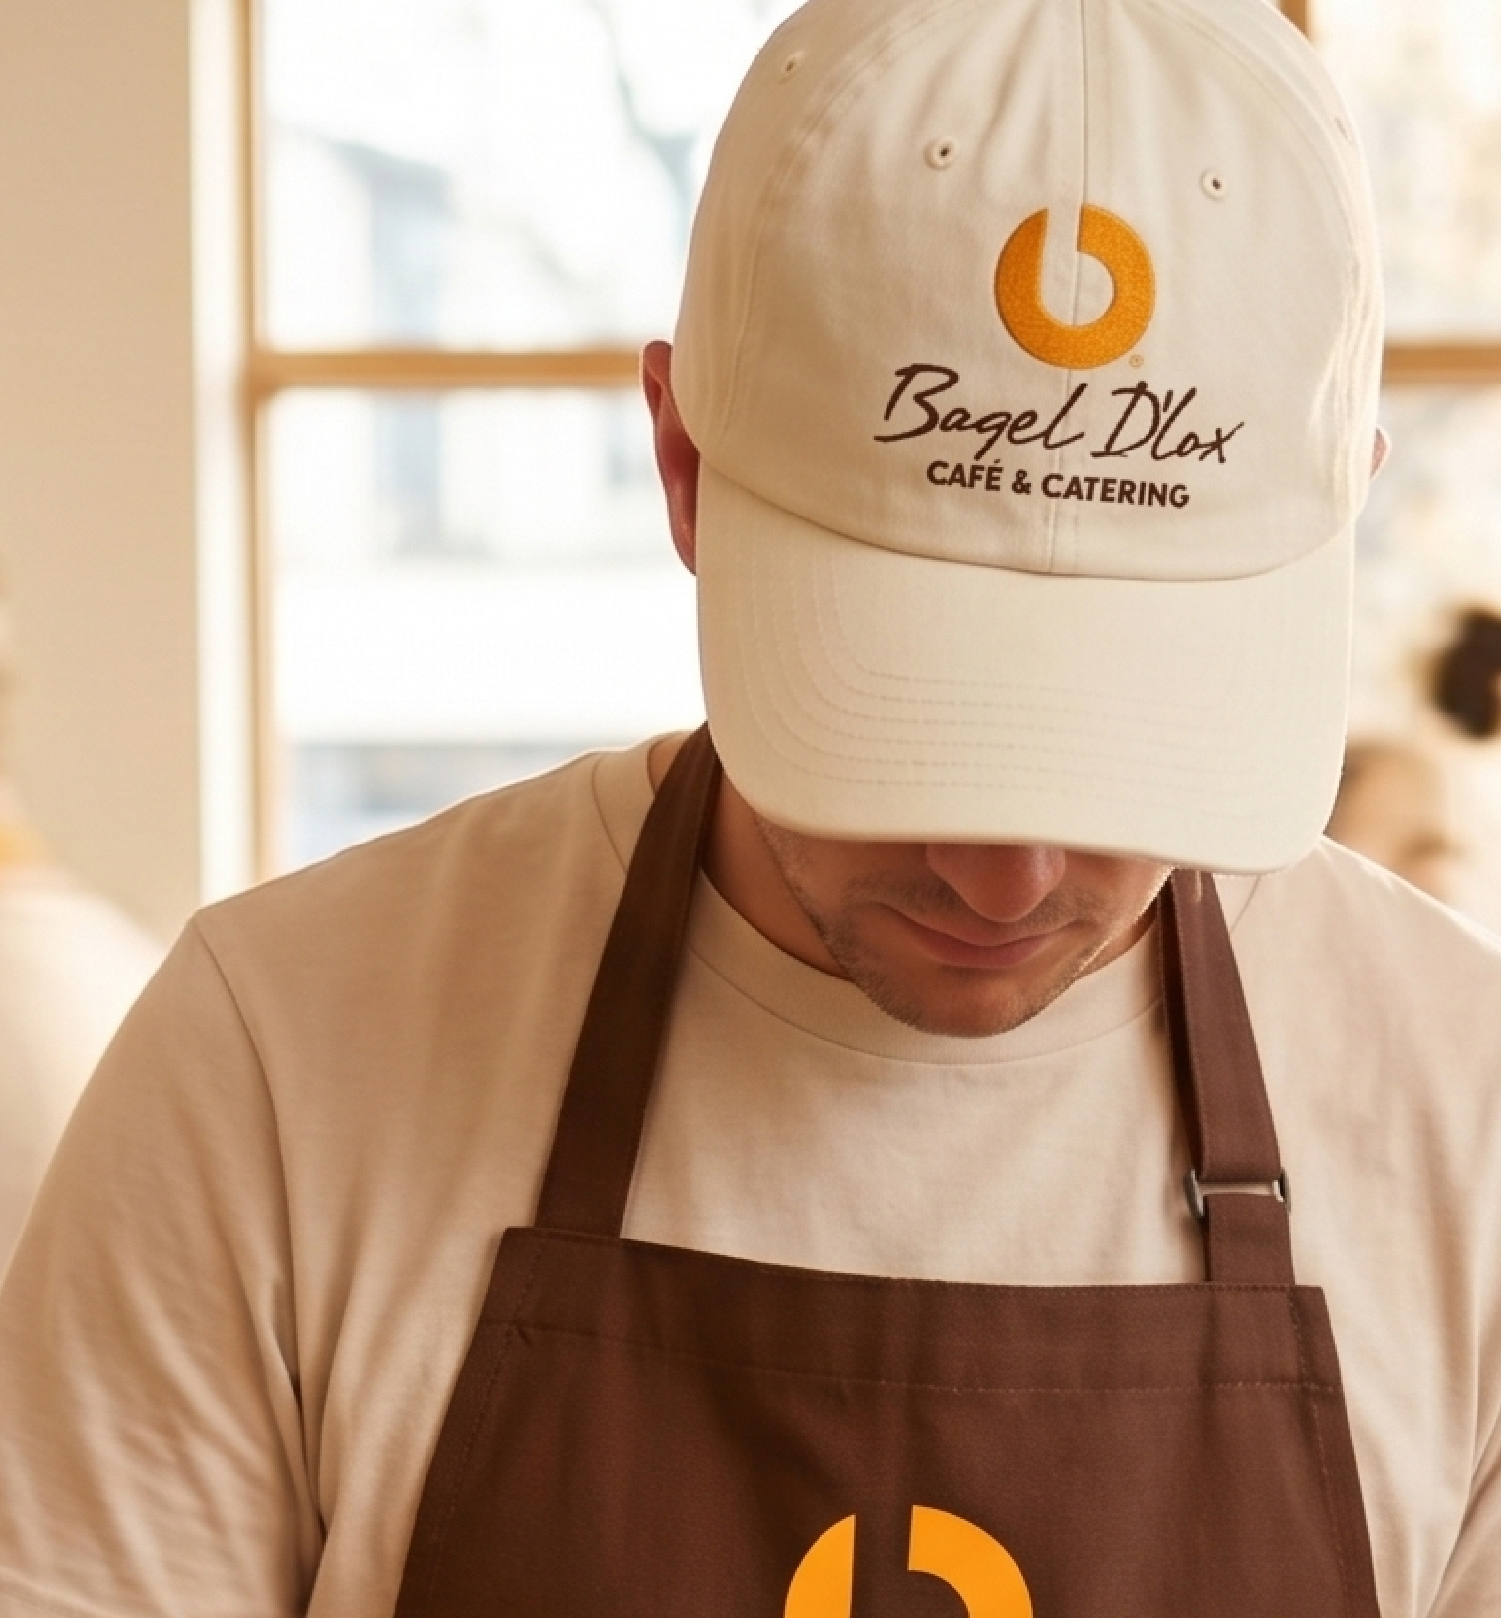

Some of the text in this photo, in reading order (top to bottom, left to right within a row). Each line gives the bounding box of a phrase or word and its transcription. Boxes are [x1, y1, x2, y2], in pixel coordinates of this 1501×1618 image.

[873, 362, 1089, 462] Bagel
[926, 458, 1190, 510] CAFÉ & CATERING
